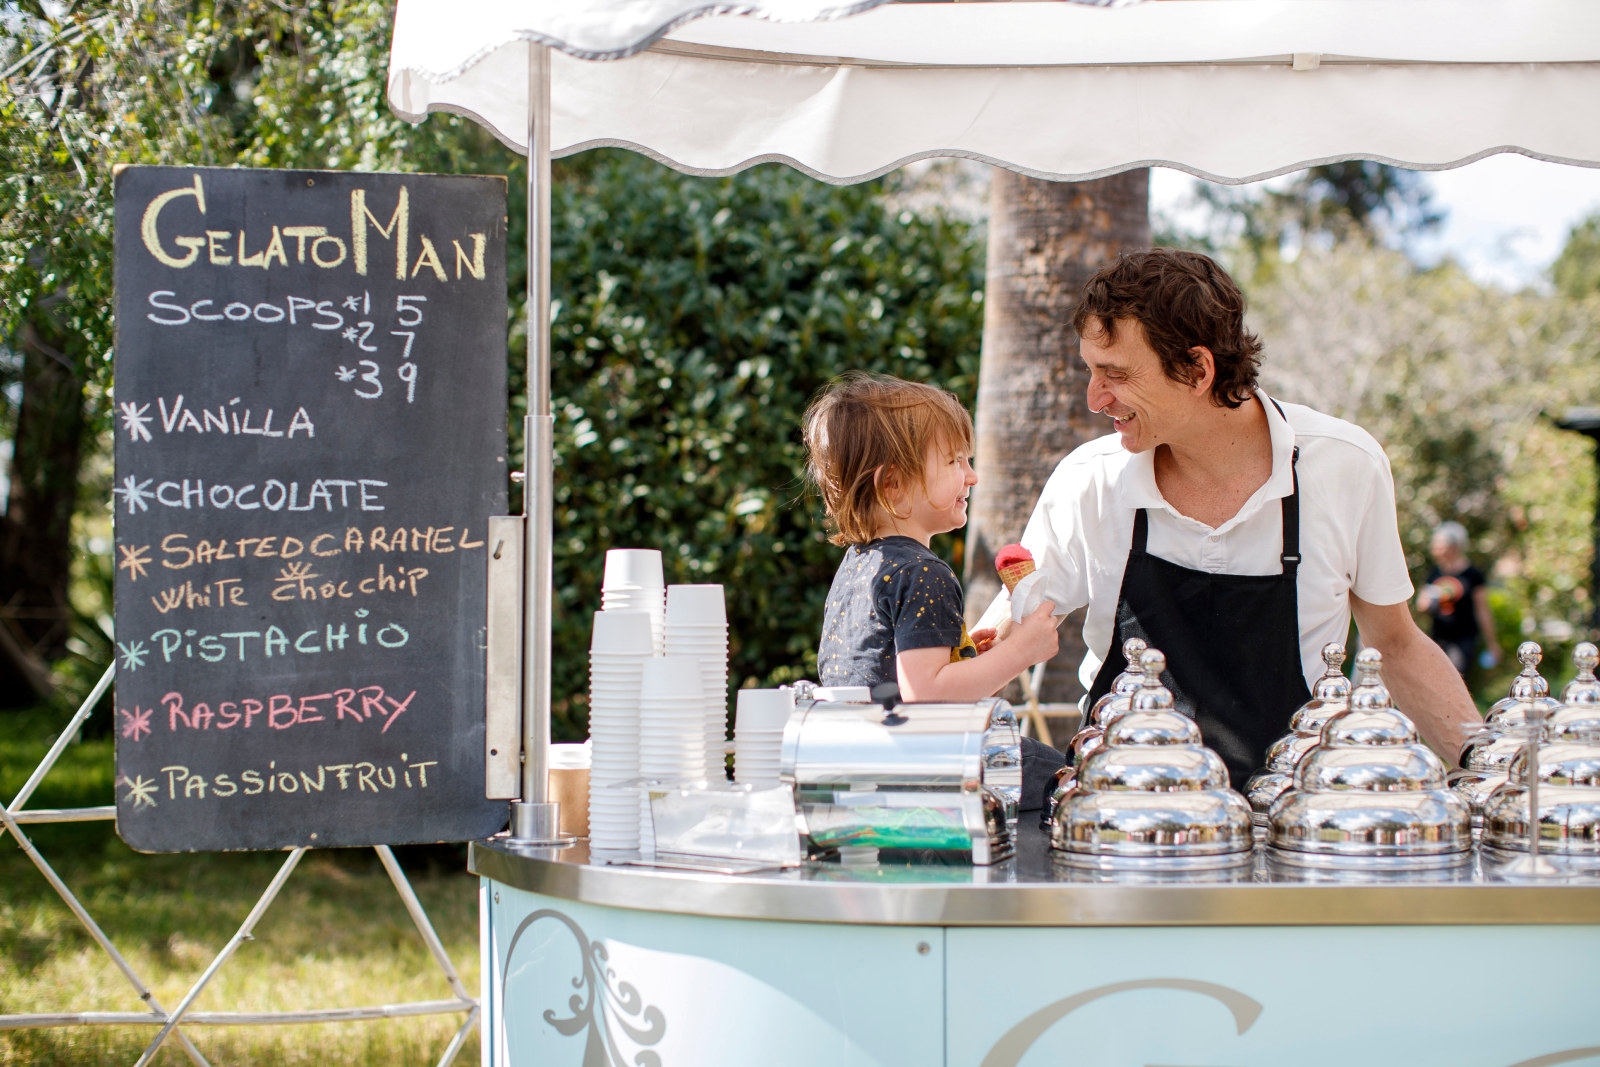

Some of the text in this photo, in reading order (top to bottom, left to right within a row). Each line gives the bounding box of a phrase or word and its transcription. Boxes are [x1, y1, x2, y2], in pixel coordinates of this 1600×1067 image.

[147, 290, 344, 330] SCOOPS
[396, 295, 427, 326] 5
[390, 331, 415, 358] 7
[399, 362, 418, 404] 9
[158, 394, 315, 439] VANiLLA
[156, 478, 388, 512] CHOCOLATE
[161, 526, 484, 570] SALTED CARAMEL
[151, 609, 409, 663] PiSTACHiO
[161, 686, 416, 734] RASPBERRY
